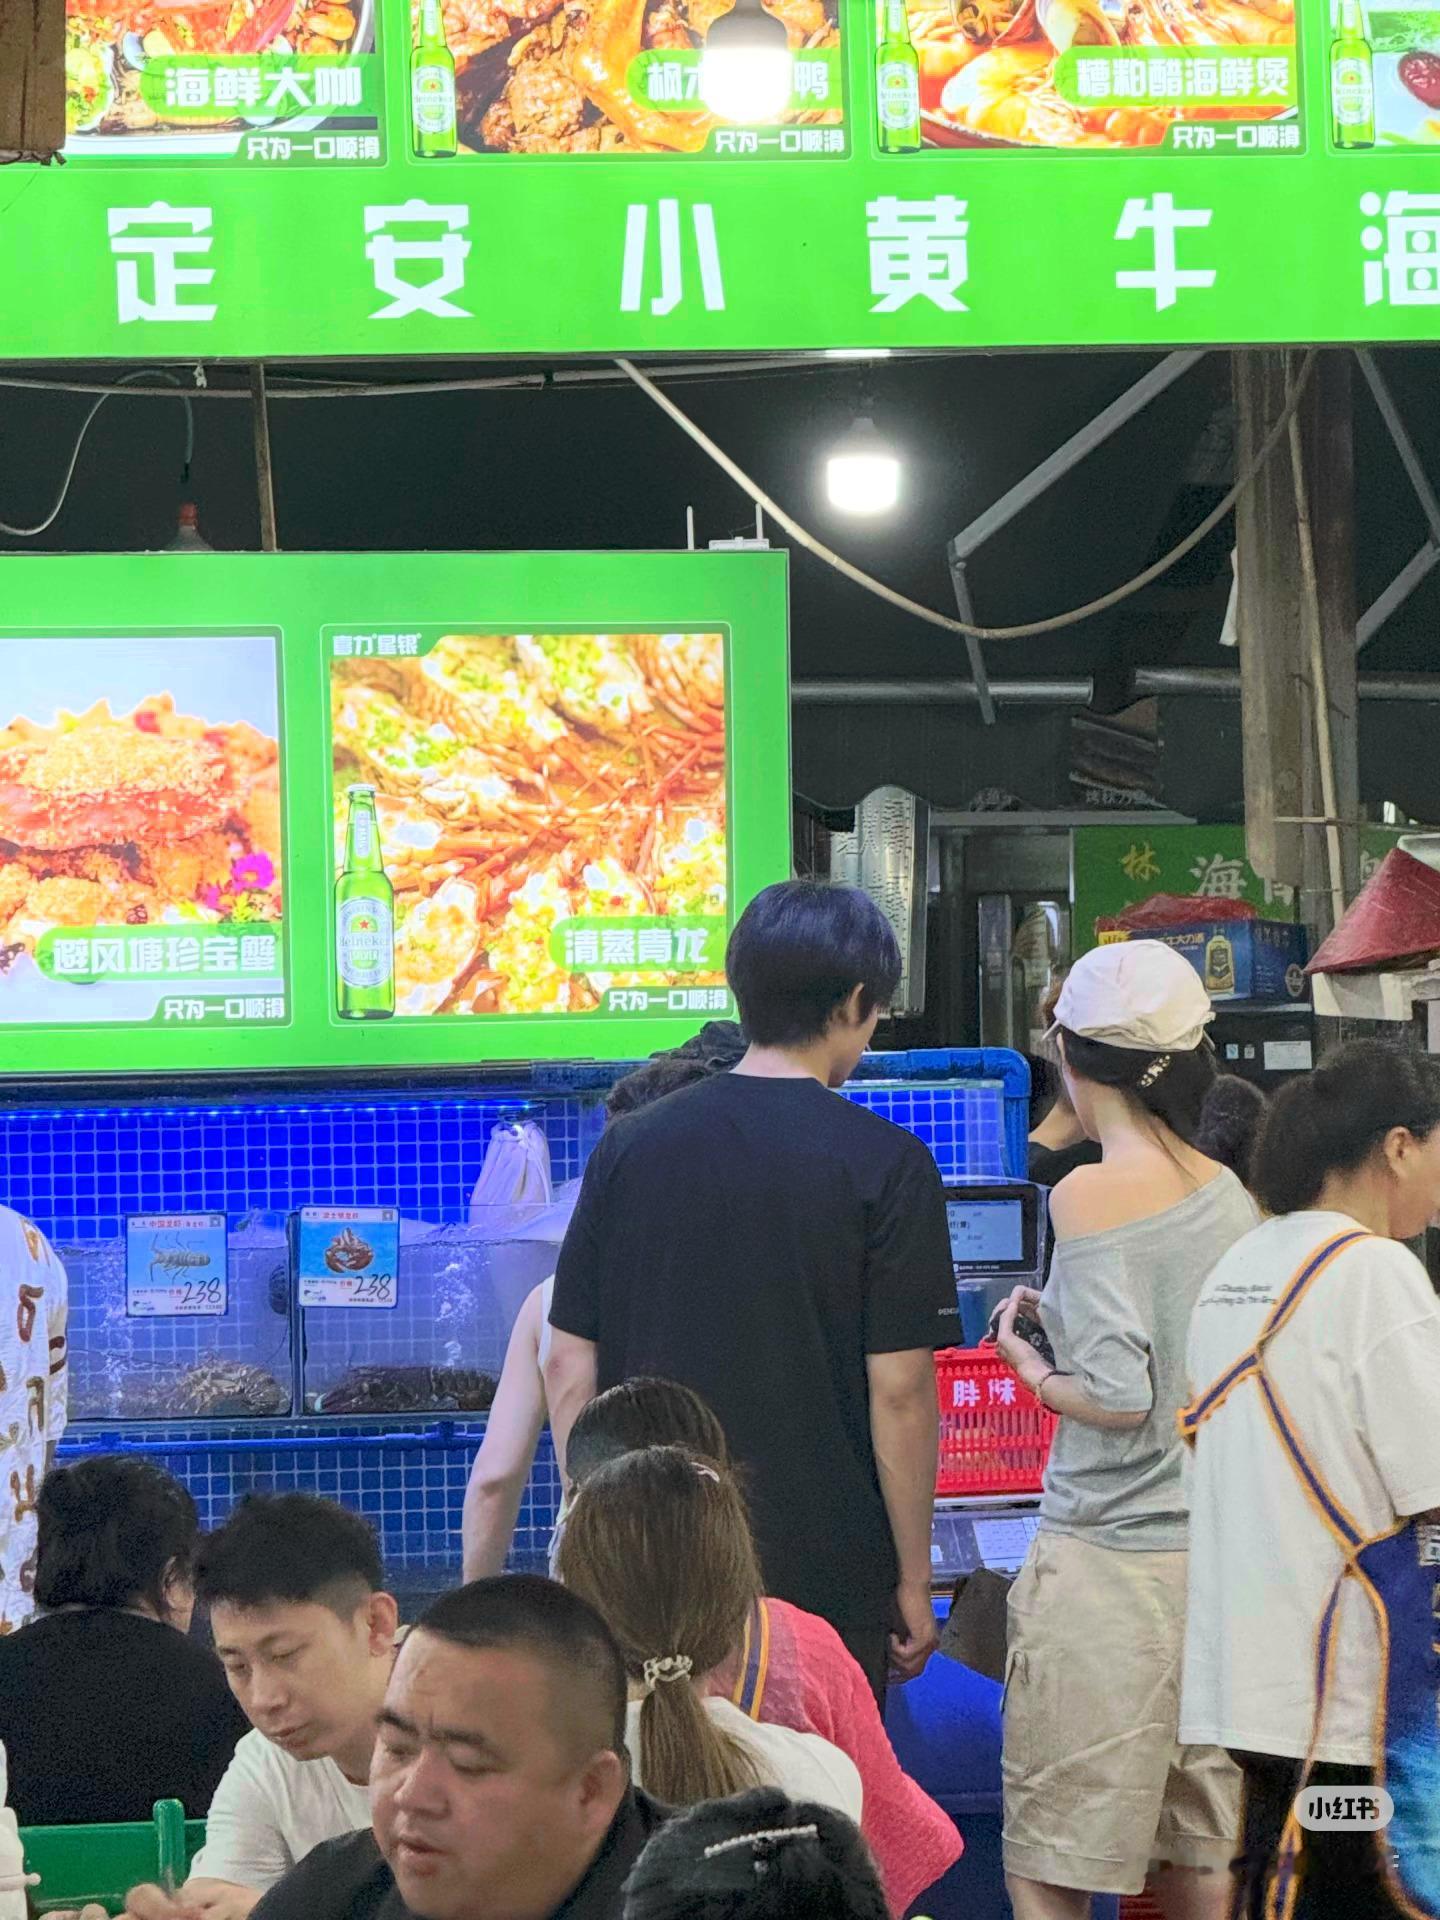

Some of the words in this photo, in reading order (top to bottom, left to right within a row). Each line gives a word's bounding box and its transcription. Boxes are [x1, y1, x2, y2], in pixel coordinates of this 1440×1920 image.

[165, 67, 362, 107] 海鲜大咖
[1076, 57, 1289, 97] 糟粕醋海鲜煲
[247, 136, 380, 160] 只为一口顺滑
[715, 129, 845, 153] 只为一口顺滑
[1173, 125, 1300, 148] 只为一口顺滑
[108, 192, 1440, 323] 定安小黄牛海
[53, 935, 276, 974] 避风塘珍宝蟹
[565, 927, 709, 964] 清蒸青龙
[163, 998, 285, 1020] 只为一口顺滑
[608, 989, 729, 1011] 只为一口顺滑
[181, 1277, 222, 1304] 238
[354, 1273, 392, 1300] 238
